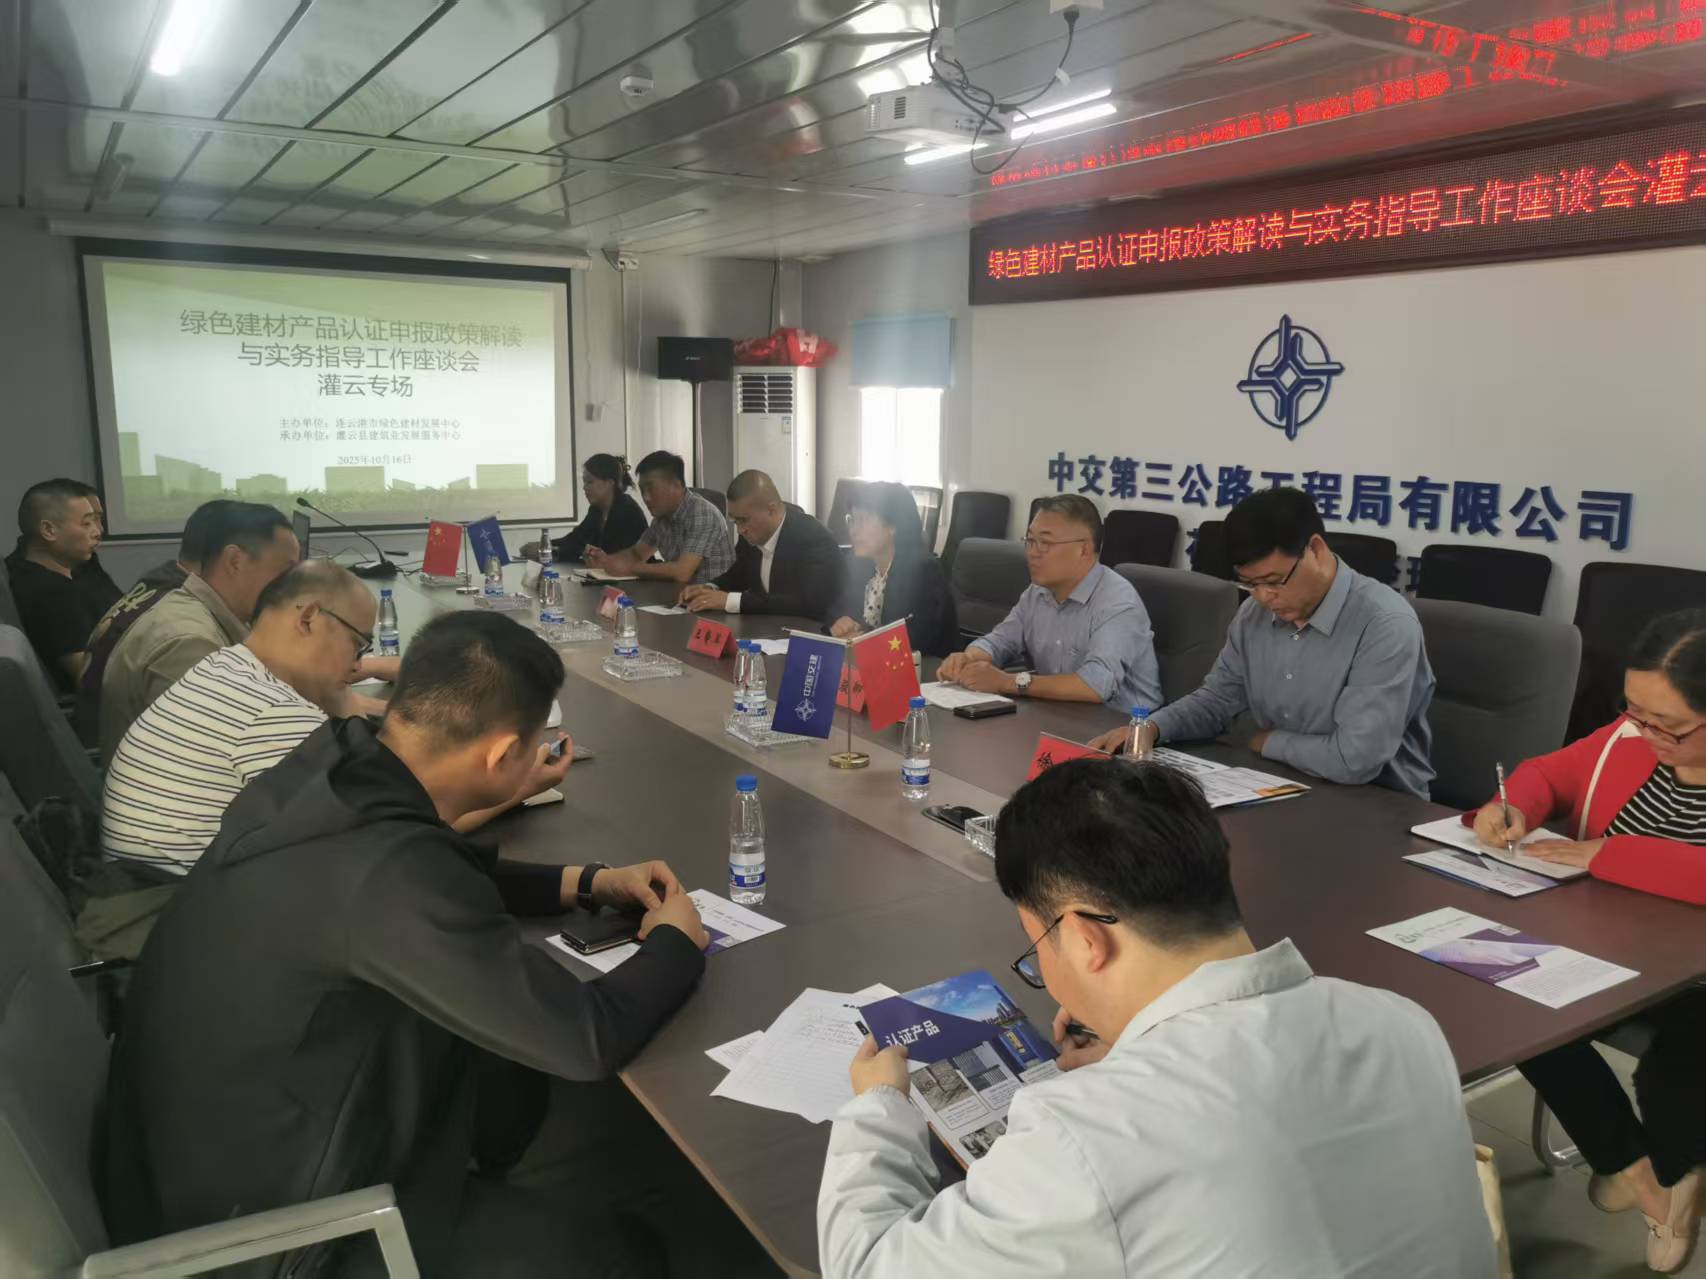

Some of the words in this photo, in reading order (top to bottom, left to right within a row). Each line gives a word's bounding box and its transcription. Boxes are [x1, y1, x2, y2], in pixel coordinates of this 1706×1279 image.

[179, 309, 523, 348] 绿色建材产品认证申报政策解读
[237, 341, 481, 373] 与实务指导工作座谈会
[317, 373, 414, 398] 灌云专场
[885, 1019, 941, 1048] 认证产品
